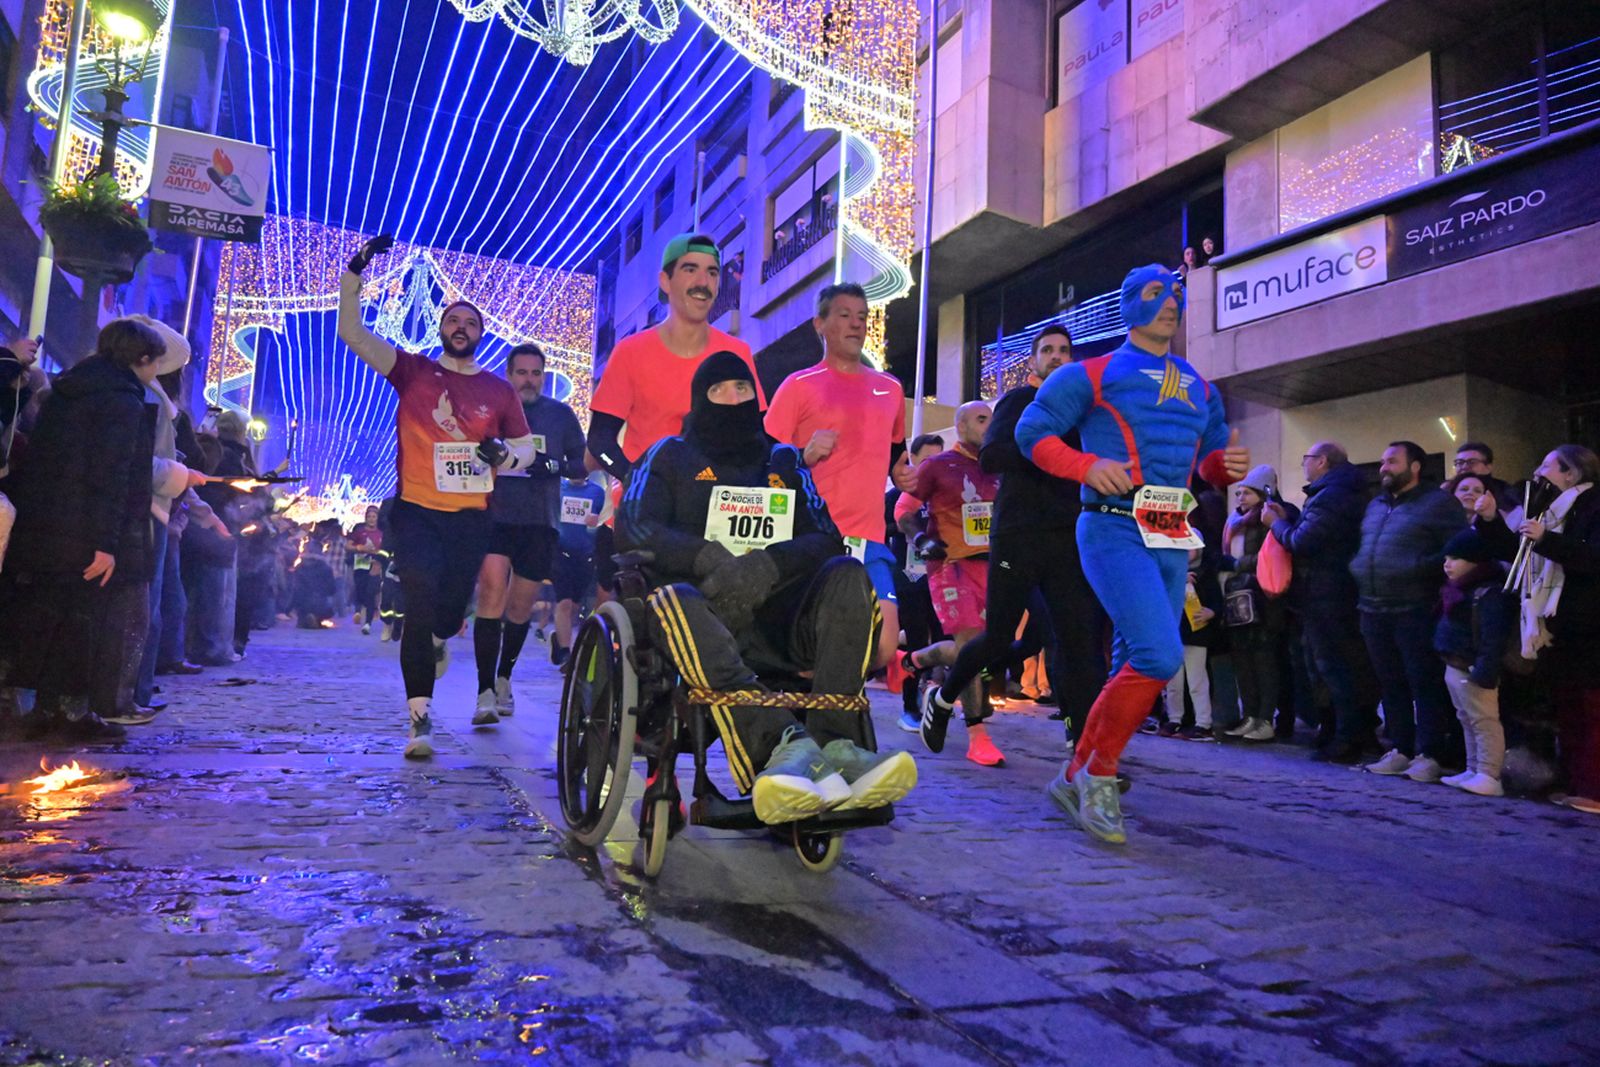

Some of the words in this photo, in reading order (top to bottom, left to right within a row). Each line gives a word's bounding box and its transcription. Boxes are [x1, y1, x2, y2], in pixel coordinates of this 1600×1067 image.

[166, 164, 197, 178] SAN
[167, 215, 245, 235] JAPEMASA
[1405, 217, 1454, 246] SAIZ
[1460, 189, 1546, 230] PARDO
[1429, 223, 1515, 255] ESTHETICS
[1253, 245, 1377, 305] muface
[1059, 281, 1075, 305] La
[446, 460, 481, 476] 315
[720, 503, 738, 512] SAN
[731, 495, 755, 504] NOCHE
[755, 496, 764, 505] DE
[566, 507, 586, 516] 3335
[728, 514, 775, 540] 1076
